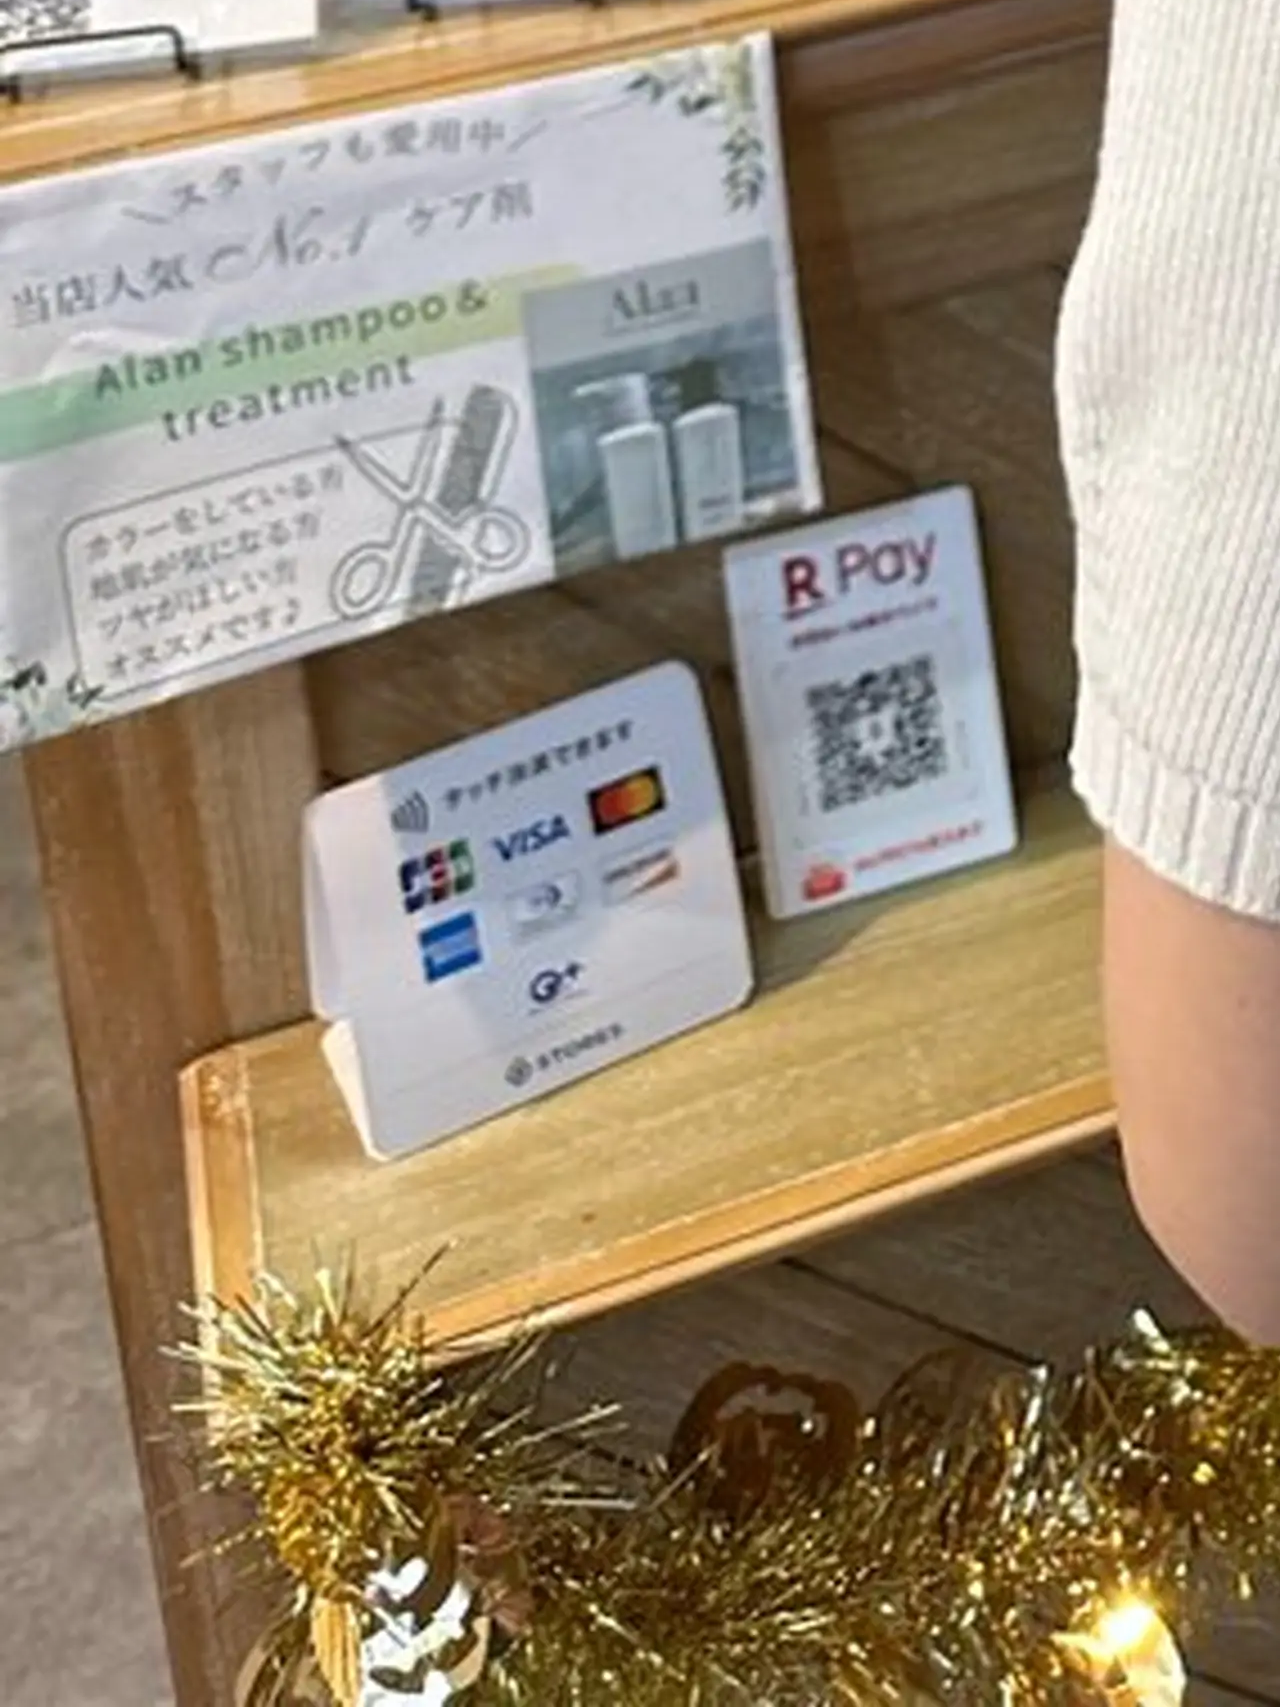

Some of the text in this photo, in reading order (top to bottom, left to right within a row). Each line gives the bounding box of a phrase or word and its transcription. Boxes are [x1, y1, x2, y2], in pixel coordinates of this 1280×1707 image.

[11, 254, 196, 326] 当店人気
[93, 278, 489, 400] Alan shampoo &
[162, 354, 416, 442] treatment
[836, 531, 937, 593] Pay
[493, 814, 572, 862] VISA
